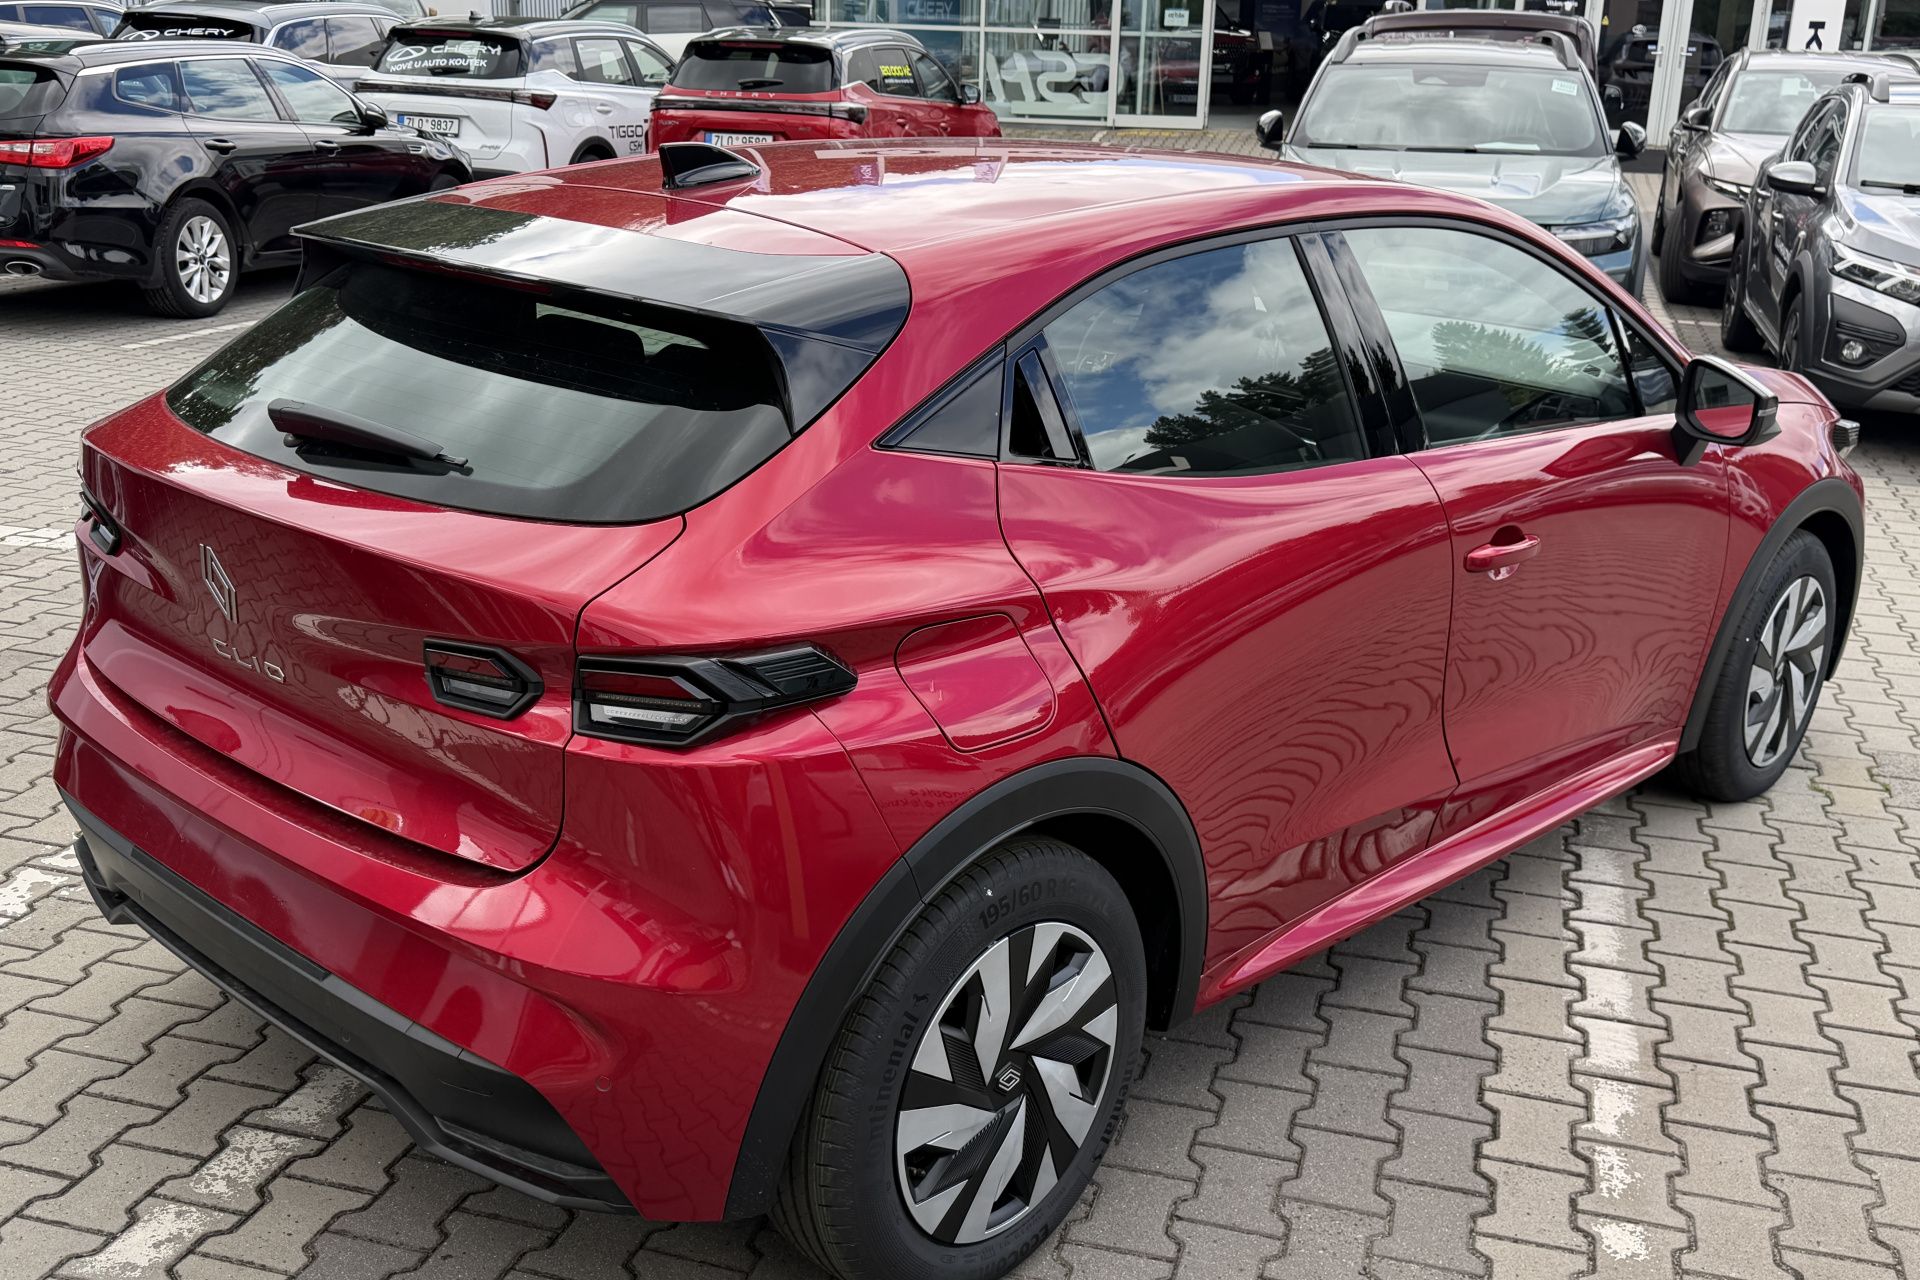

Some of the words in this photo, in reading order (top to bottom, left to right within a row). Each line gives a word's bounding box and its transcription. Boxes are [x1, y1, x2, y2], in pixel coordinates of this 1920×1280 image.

[907, 1, 953, 20] CHERY
[163, 27, 235, 37] CHERY
[431, 44, 502, 56] CHERY
[414, 59, 421, 68] U
[422, 58, 448, 68] AUTO
[449, 58, 488, 68] KOUTEK
[705, 90, 776, 98] CHERY
[430, 119, 454, 131] 9837
[608, 124, 644, 139] TIGGO
[212, 638, 285, 684] CLIO
[978, 881, 1042, 931] 195/60
[1046, 877, 1058, 898] R
